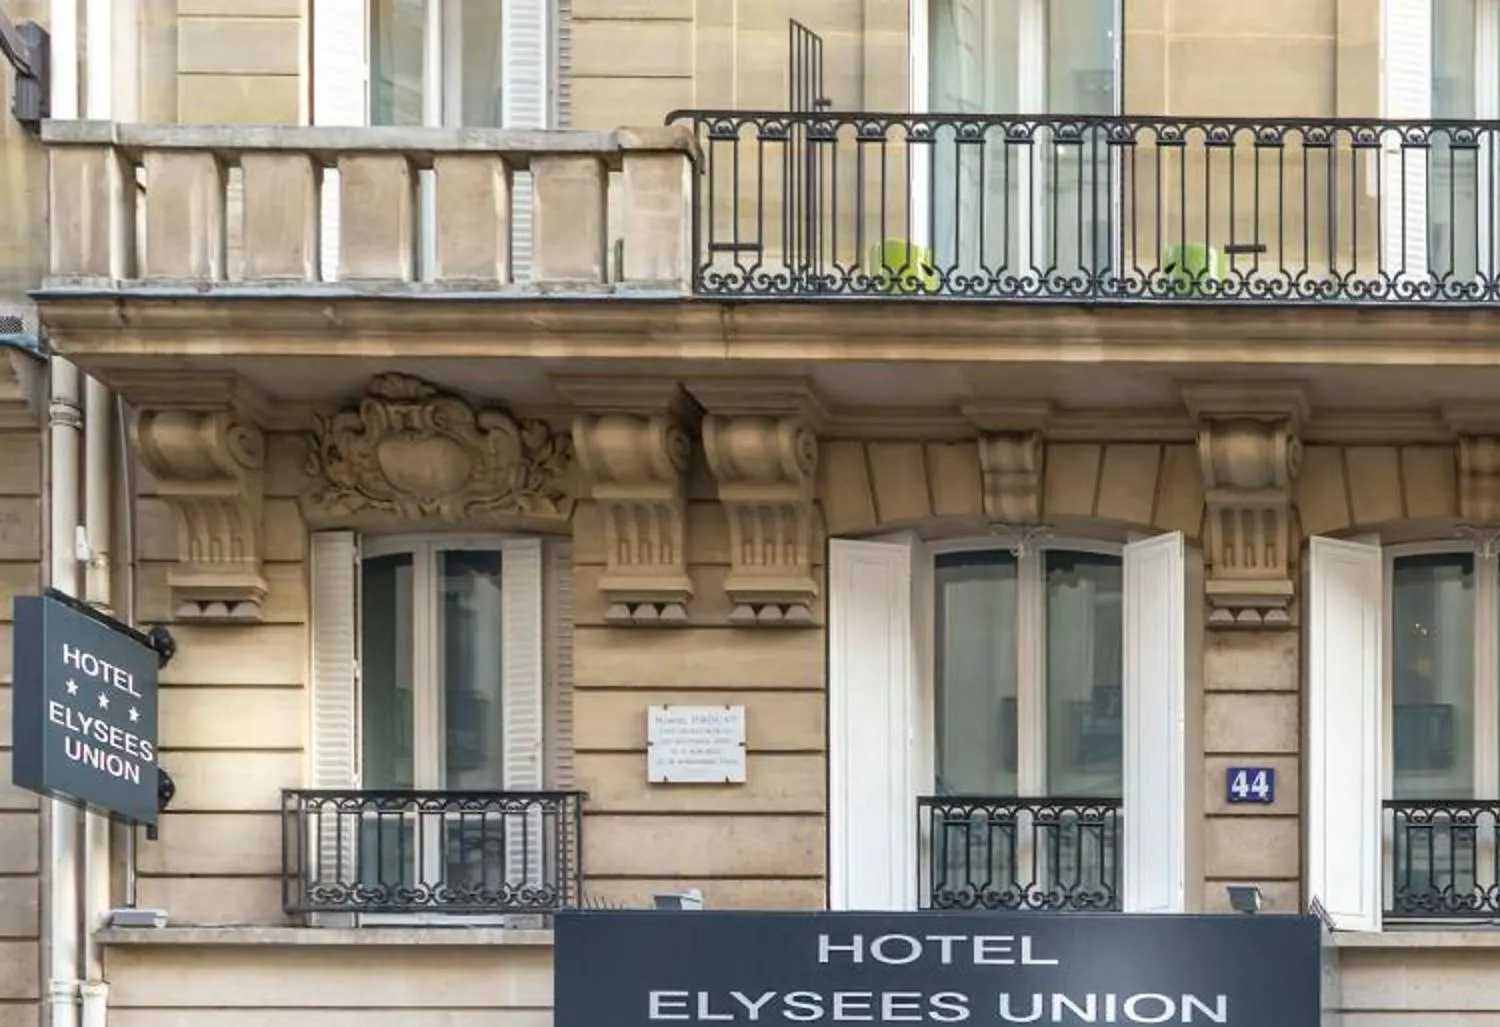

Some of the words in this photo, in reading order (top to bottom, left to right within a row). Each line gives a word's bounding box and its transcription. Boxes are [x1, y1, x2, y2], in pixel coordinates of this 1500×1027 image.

[63, 643, 142, 698] HOTEL
[50, 701, 153, 762] ELYSEES
[65, 736, 141, 785] UNION
[1231, 770, 1269, 798] 44
[818, 933, 1059, 965] HOTEL
[648, 990, 971, 1023] ELYSEES
[999, 992, 1228, 1024] UNION
